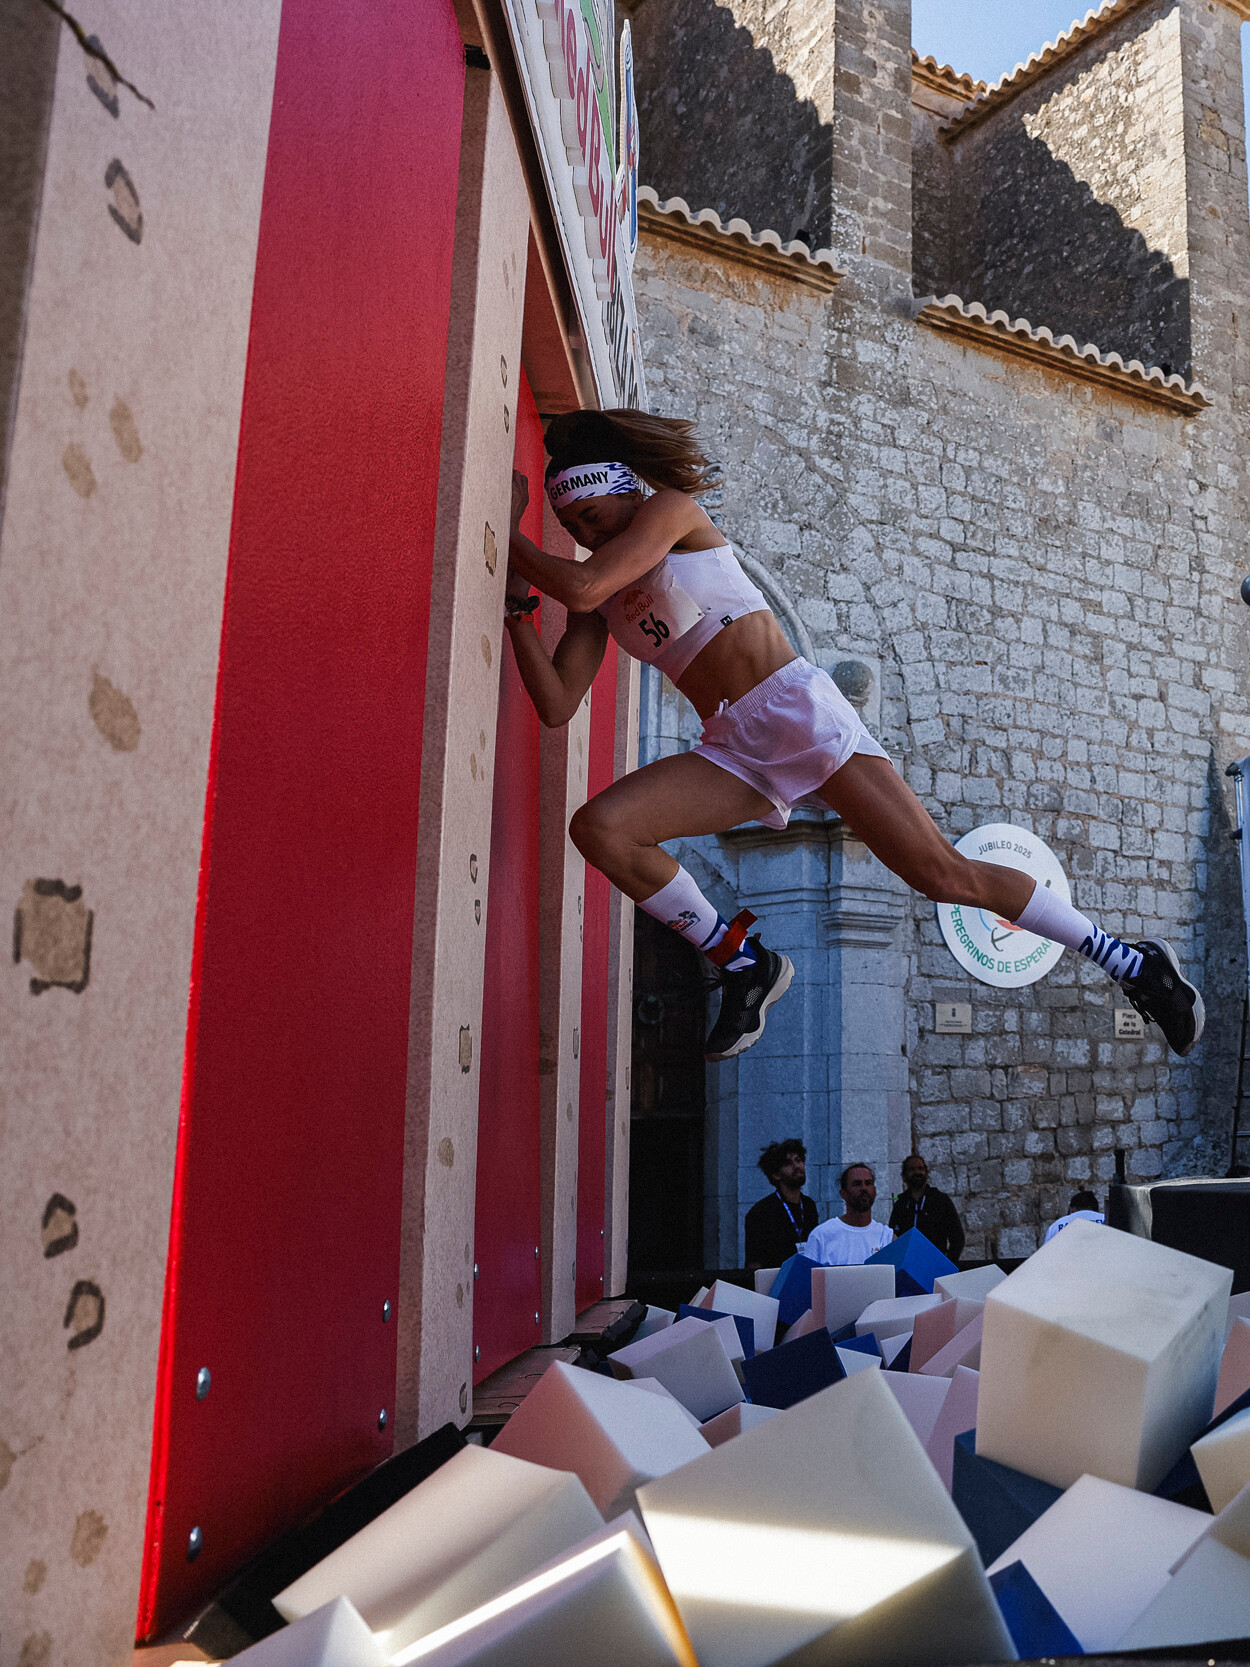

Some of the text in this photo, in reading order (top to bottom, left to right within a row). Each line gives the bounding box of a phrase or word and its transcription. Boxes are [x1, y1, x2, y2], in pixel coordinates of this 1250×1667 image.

[588, 87, 617, 295] Bull
[550, 471, 609, 500] GERMANY
[626, 593, 655, 623] Red Bull
[639, 611, 670, 648] 56
[978, 840, 1032, 859] JUBILEO 2025
[997, 960, 1012, 973] DE
